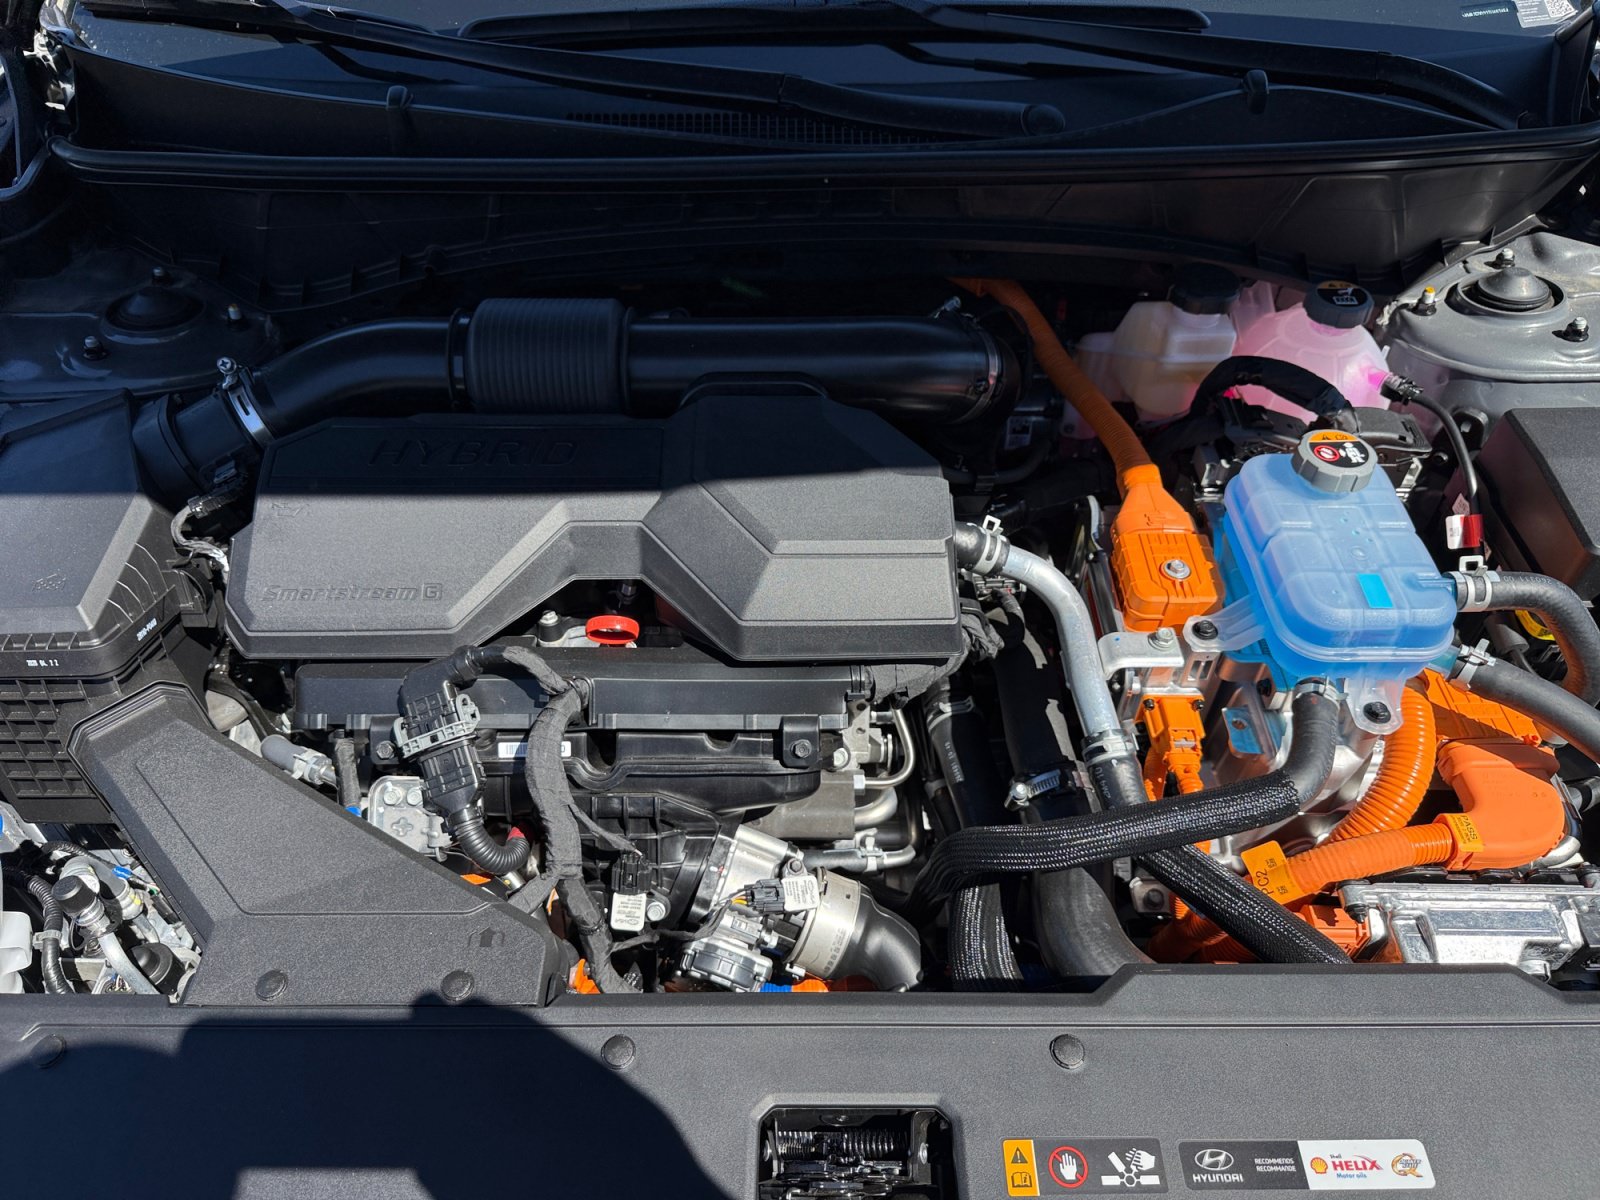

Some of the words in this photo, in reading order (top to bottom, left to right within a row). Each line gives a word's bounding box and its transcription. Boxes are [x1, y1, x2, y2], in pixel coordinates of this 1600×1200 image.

[368, 439, 578, 466] HYBRID
[261, 584, 419, 601] Smartstream
[423, 584, 441, 600] G
[1460, 814, 1478, 840] PASS
[1331, 1160, 1381, 1171] HELIX
[1192, 1173, 1244, 1183] HYUNDAI
